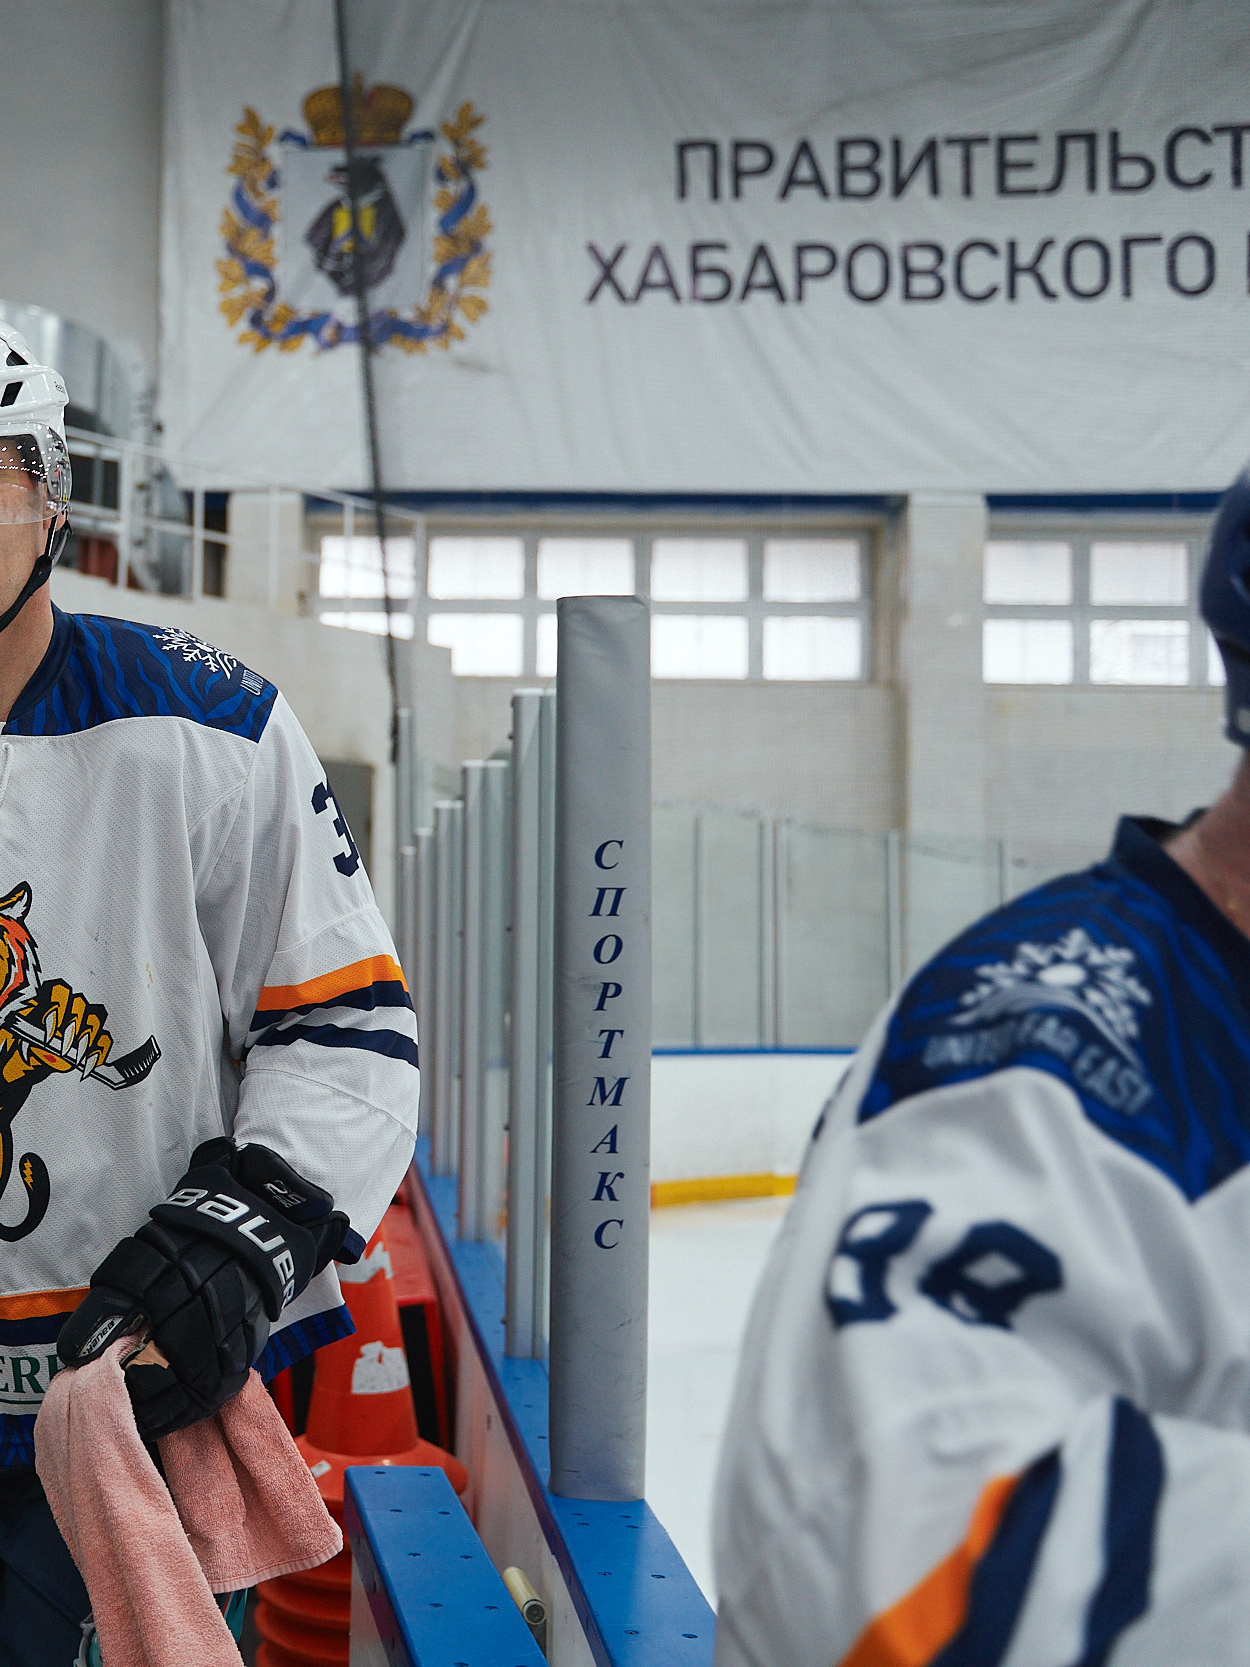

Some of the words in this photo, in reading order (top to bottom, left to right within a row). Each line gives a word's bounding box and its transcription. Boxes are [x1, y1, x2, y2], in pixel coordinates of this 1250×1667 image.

[674, 123, 1250, 201] ПРАВИТЕЛЬСТ
[584, 232, 1217, 304] ХАБАРОВСКОГО
[588, 839, 630, 1250] СПОРТМАКС
[167, 1187, 296, 1310] BAUER
